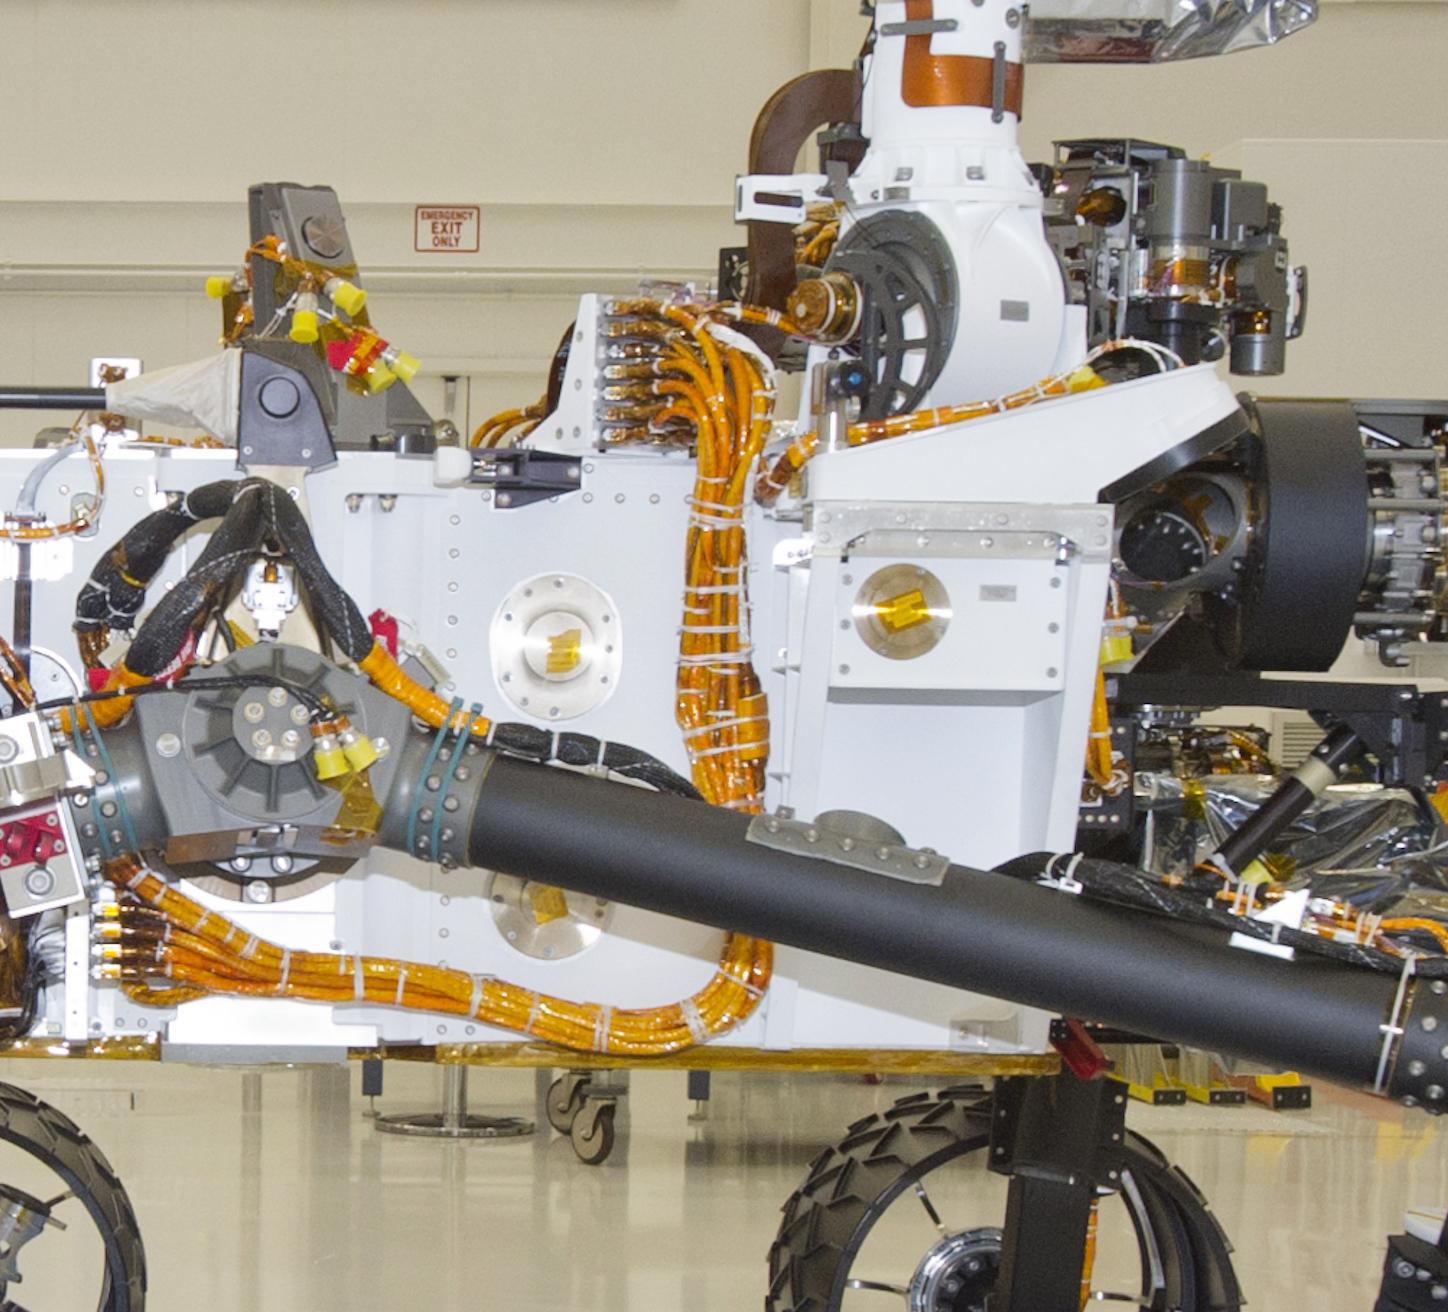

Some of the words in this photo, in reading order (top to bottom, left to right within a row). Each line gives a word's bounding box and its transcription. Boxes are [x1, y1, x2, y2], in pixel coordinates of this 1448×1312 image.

[420, 210, 474, 221] EMERGENCY
[431, 221, 463, 235] EXIT
[432, 235, 461, 247] ONLY
